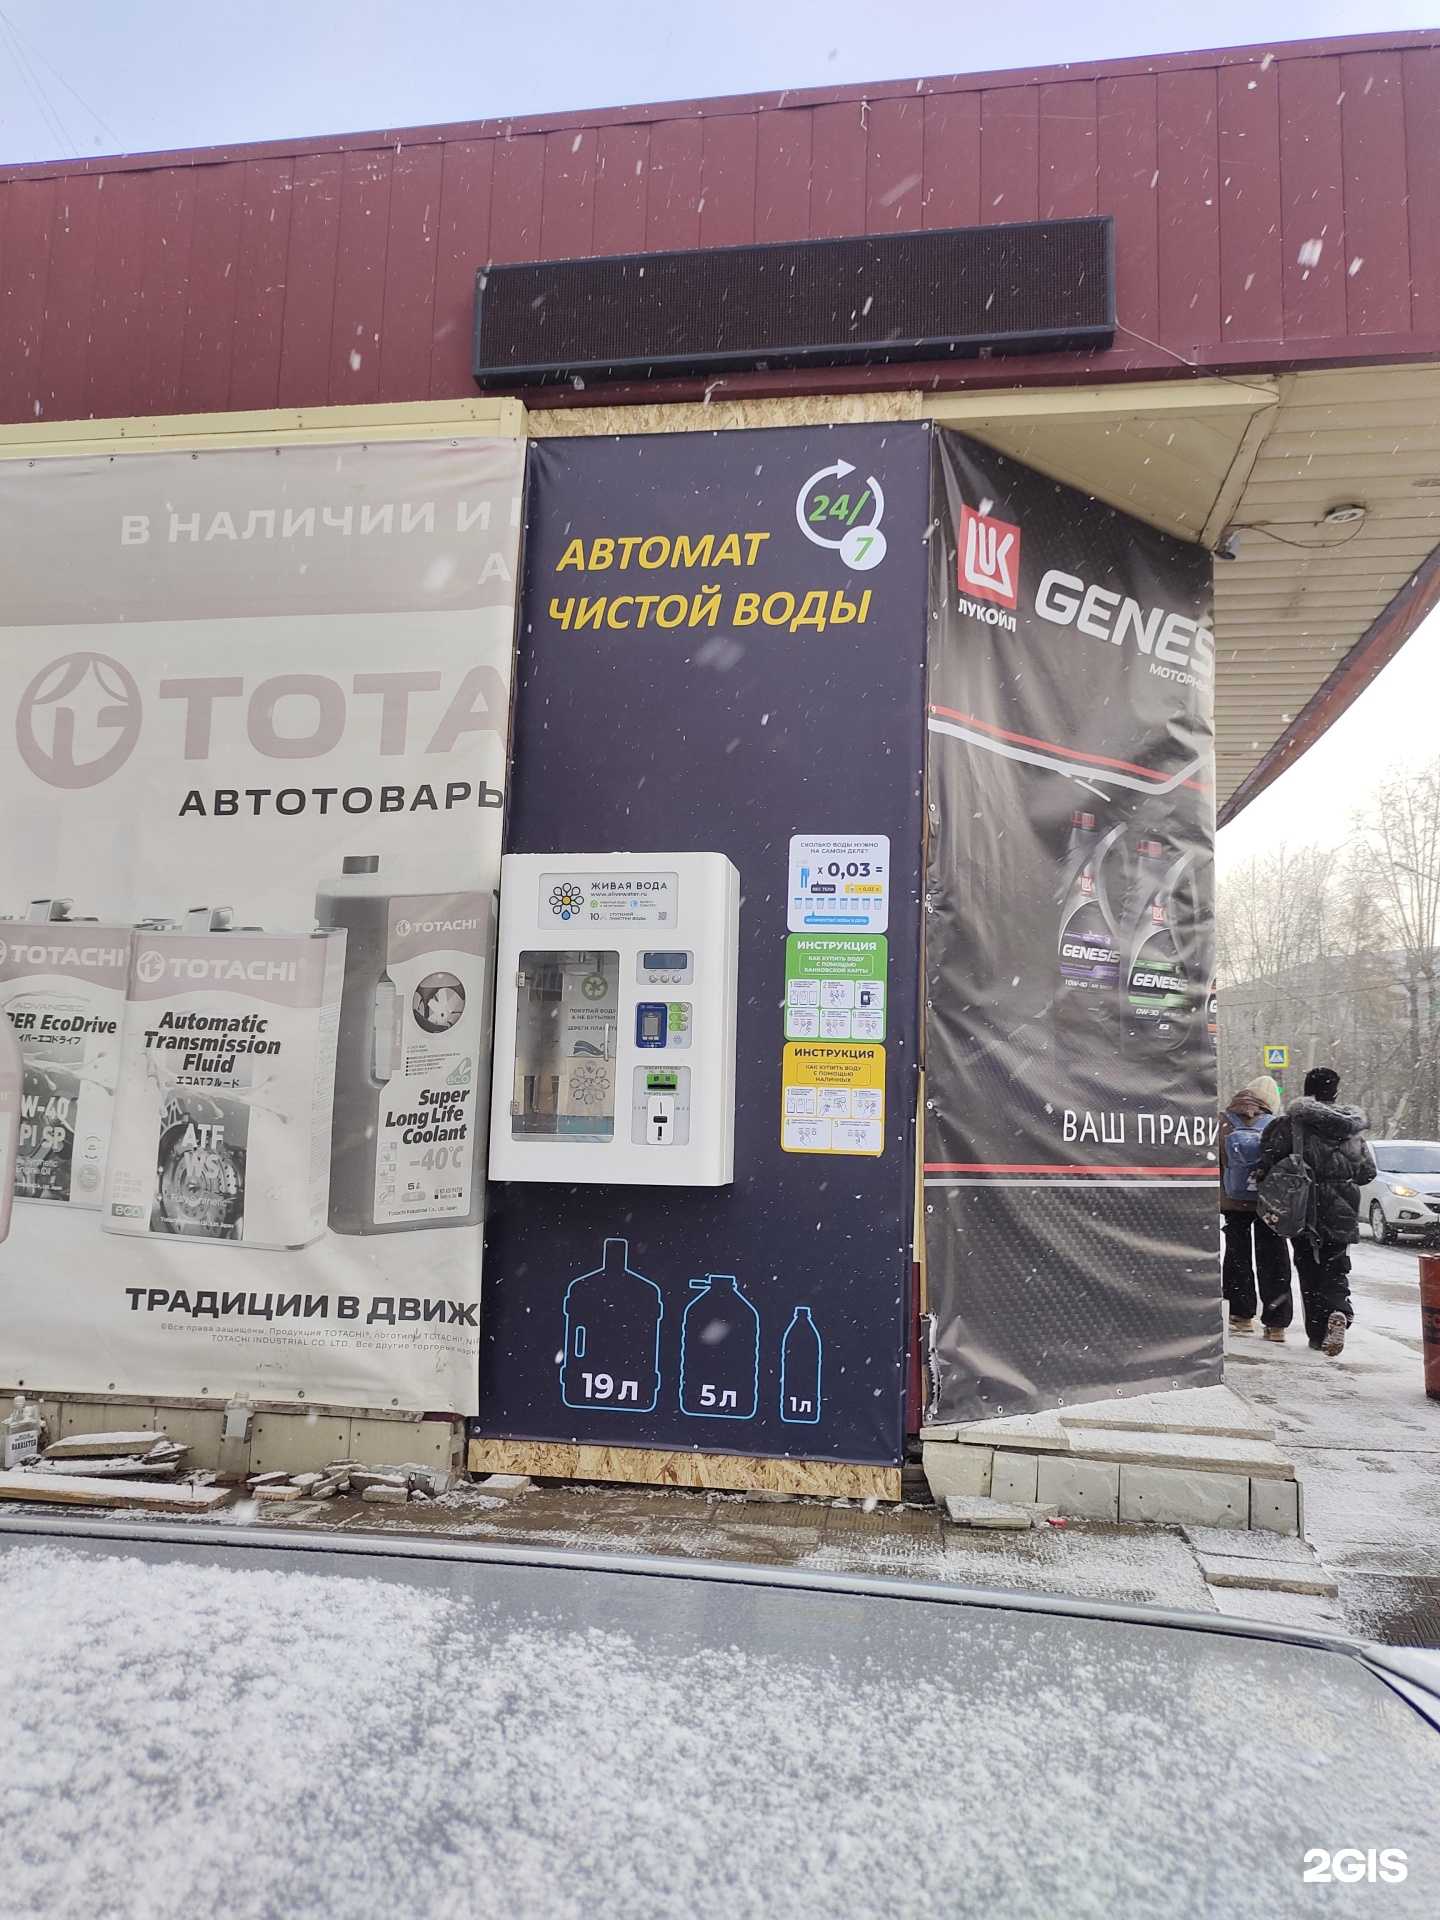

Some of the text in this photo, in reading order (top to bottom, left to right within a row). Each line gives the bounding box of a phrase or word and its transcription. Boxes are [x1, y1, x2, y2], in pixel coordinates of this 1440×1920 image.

[121, 514, 151, 545] В
[168, 503, 435, 543] НАЛИЧИИ
[457, 501, 490, 532] И
[556, 532, 770, 571] АВТОМАТ
[549, 585, 872, 633] ЧИСТОЙ ВОДЫ
[958, 598, 1017, 632] ЛУКОЙЛ
[1035, 569, 1215, 677] GENES
[159, 664, 509, 760] TOTA
[827, 862, 871, 880] 0,03
[591, 881, 668, 891] ЖИВАЯ ВОДА
[413, 919, 477, 934] TOTACHI
[11, 944, 125, 968] TOTACHI
[797, 941, 877, 951] ИНСТРУКЦИЯ
[1062, 943, 1120, 963] GENESIS
[168, 958, 297, 982] TOTACHI
[1132, 973, 1189, 992] GENESIS
[40, 1014, 117, 1034] EcoDrive
[158, 1011, 269, 1034] Automatic
[144, 1031, 282, 1055] Transmission
[794, 1048, 875, 1059] ИНСТРУКЦИЯ
[183, 1053, 236, 1074] Fluid
[418, 1089, 471, 1109] Super
[385, 1105, 464, 1130] Long Life
[1063, 1110, 1220, 1146] ВАШ ПРАВИ
[182, 1123, 225, 1150] ATF
[402, 1123, 468, 1145] Coolant
[125, 1287, 479, 1327] ТРАДИЦИИ В ДВИЖ
[582, 1373, 613, 1399] 19
[700, 1384, 716, 1407] 5
